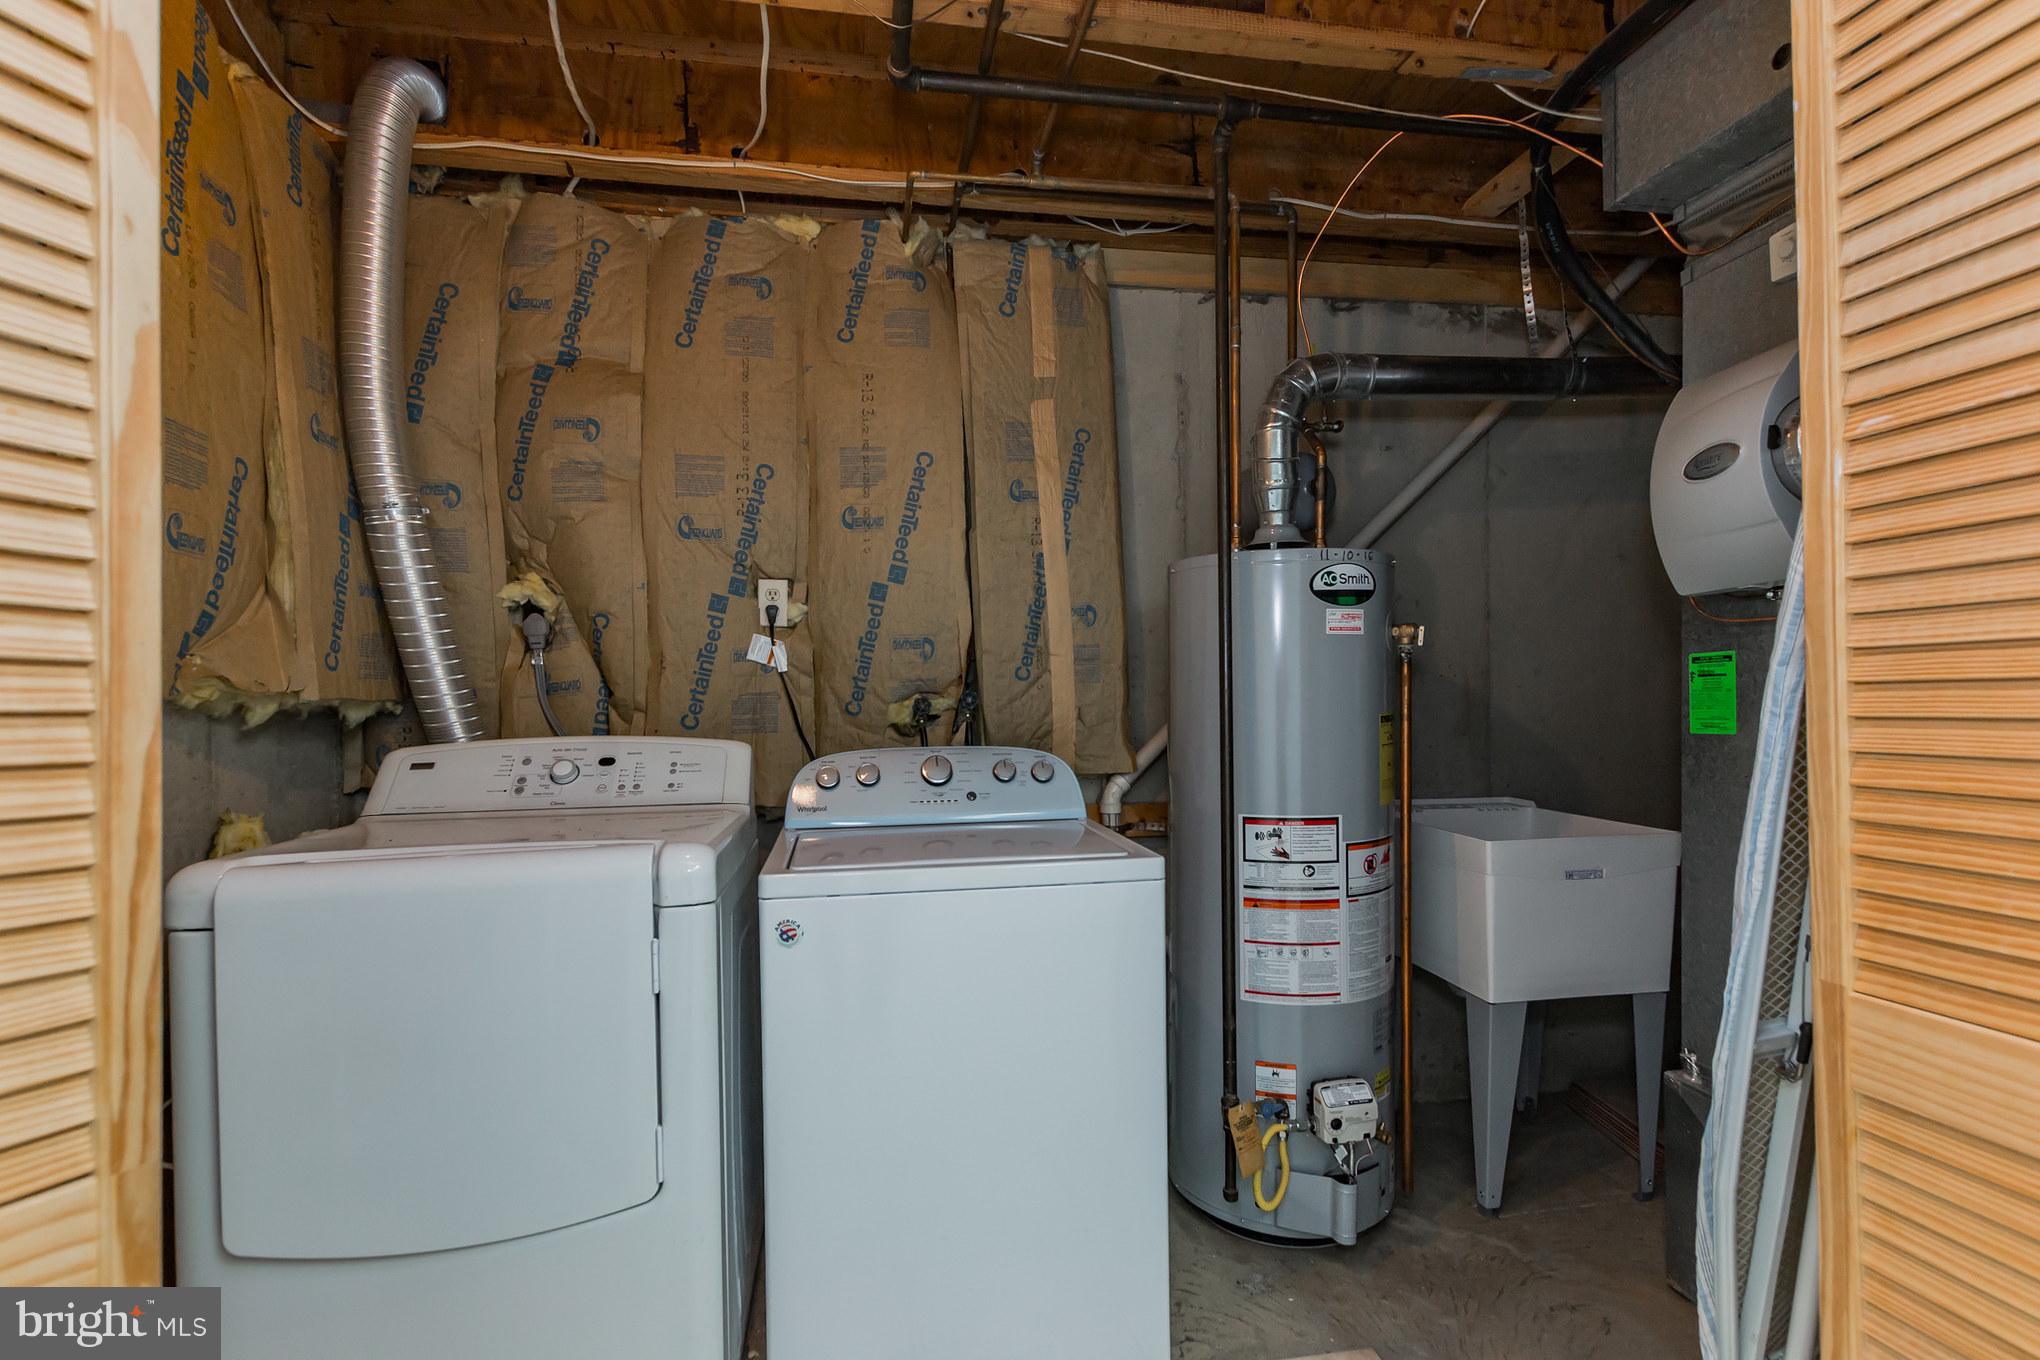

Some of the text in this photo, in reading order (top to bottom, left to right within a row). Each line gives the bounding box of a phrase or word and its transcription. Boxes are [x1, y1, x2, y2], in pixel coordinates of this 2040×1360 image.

[160, 97, 194, 256] CertainTeed
[404, 283, 460, 401] CertainTeed
[559, 239, 611, 352] CertainTeed
[675, 237, 723, 349] CertainTeed
[836, 234, 880, 344] CertainTeed
[507, 382, 549, 501] CertainTeed
[205, 455, 250, 611] CertainTeed
[732, 463, 775, 576] CertainTeed
[890, 451, 934, 563] CertainTeed
[324, 538, 350, 673] CertainTeed
[1339, 573, 1370, 585] Smith
[679, 613, 724, 731] CertainTeed
[844, 602, 885, 718] CertainTeed
